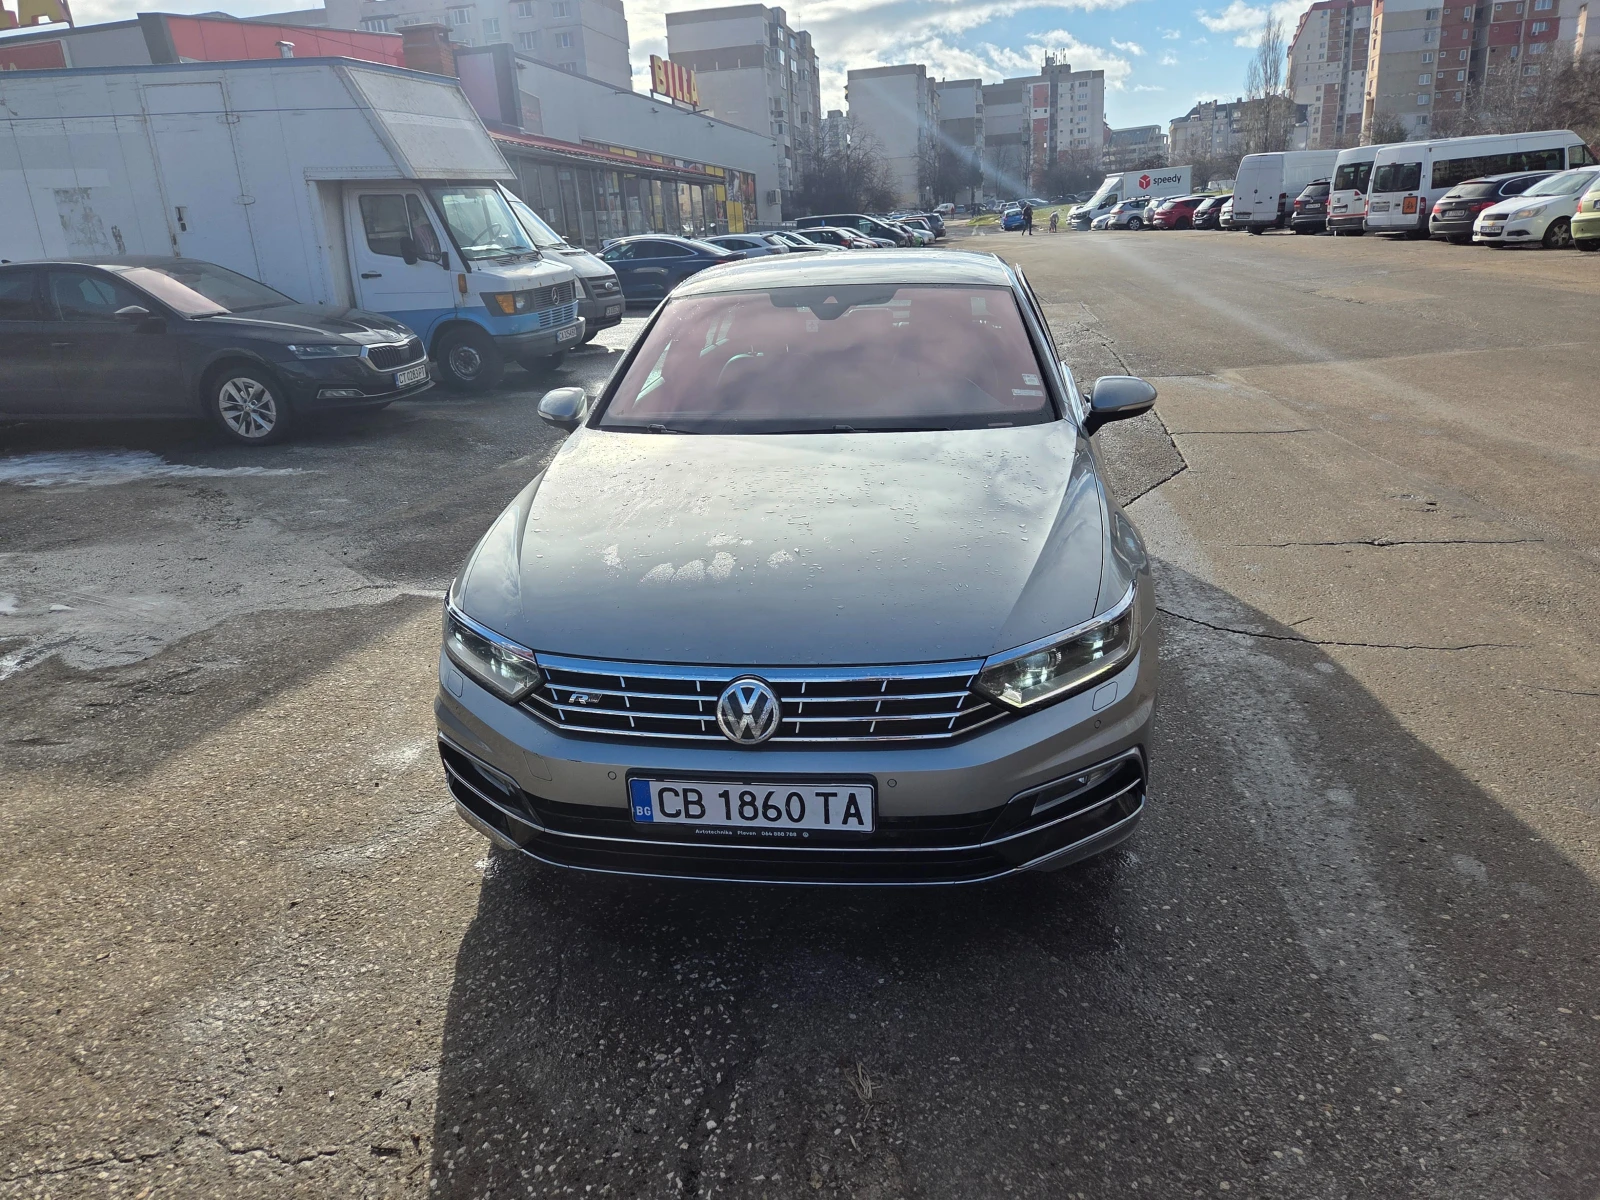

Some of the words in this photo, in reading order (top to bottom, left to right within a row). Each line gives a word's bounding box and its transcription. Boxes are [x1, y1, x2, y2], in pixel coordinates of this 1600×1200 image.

[649, 54, 700, 107] BILLA
[1153, 174, 1182, 186] speedy
[636, 805, 652, 817] BG
[657, 786, 706, 819] CB
[718, 789, 806, 823] 1860
[815, 791, 865, 826] TA
